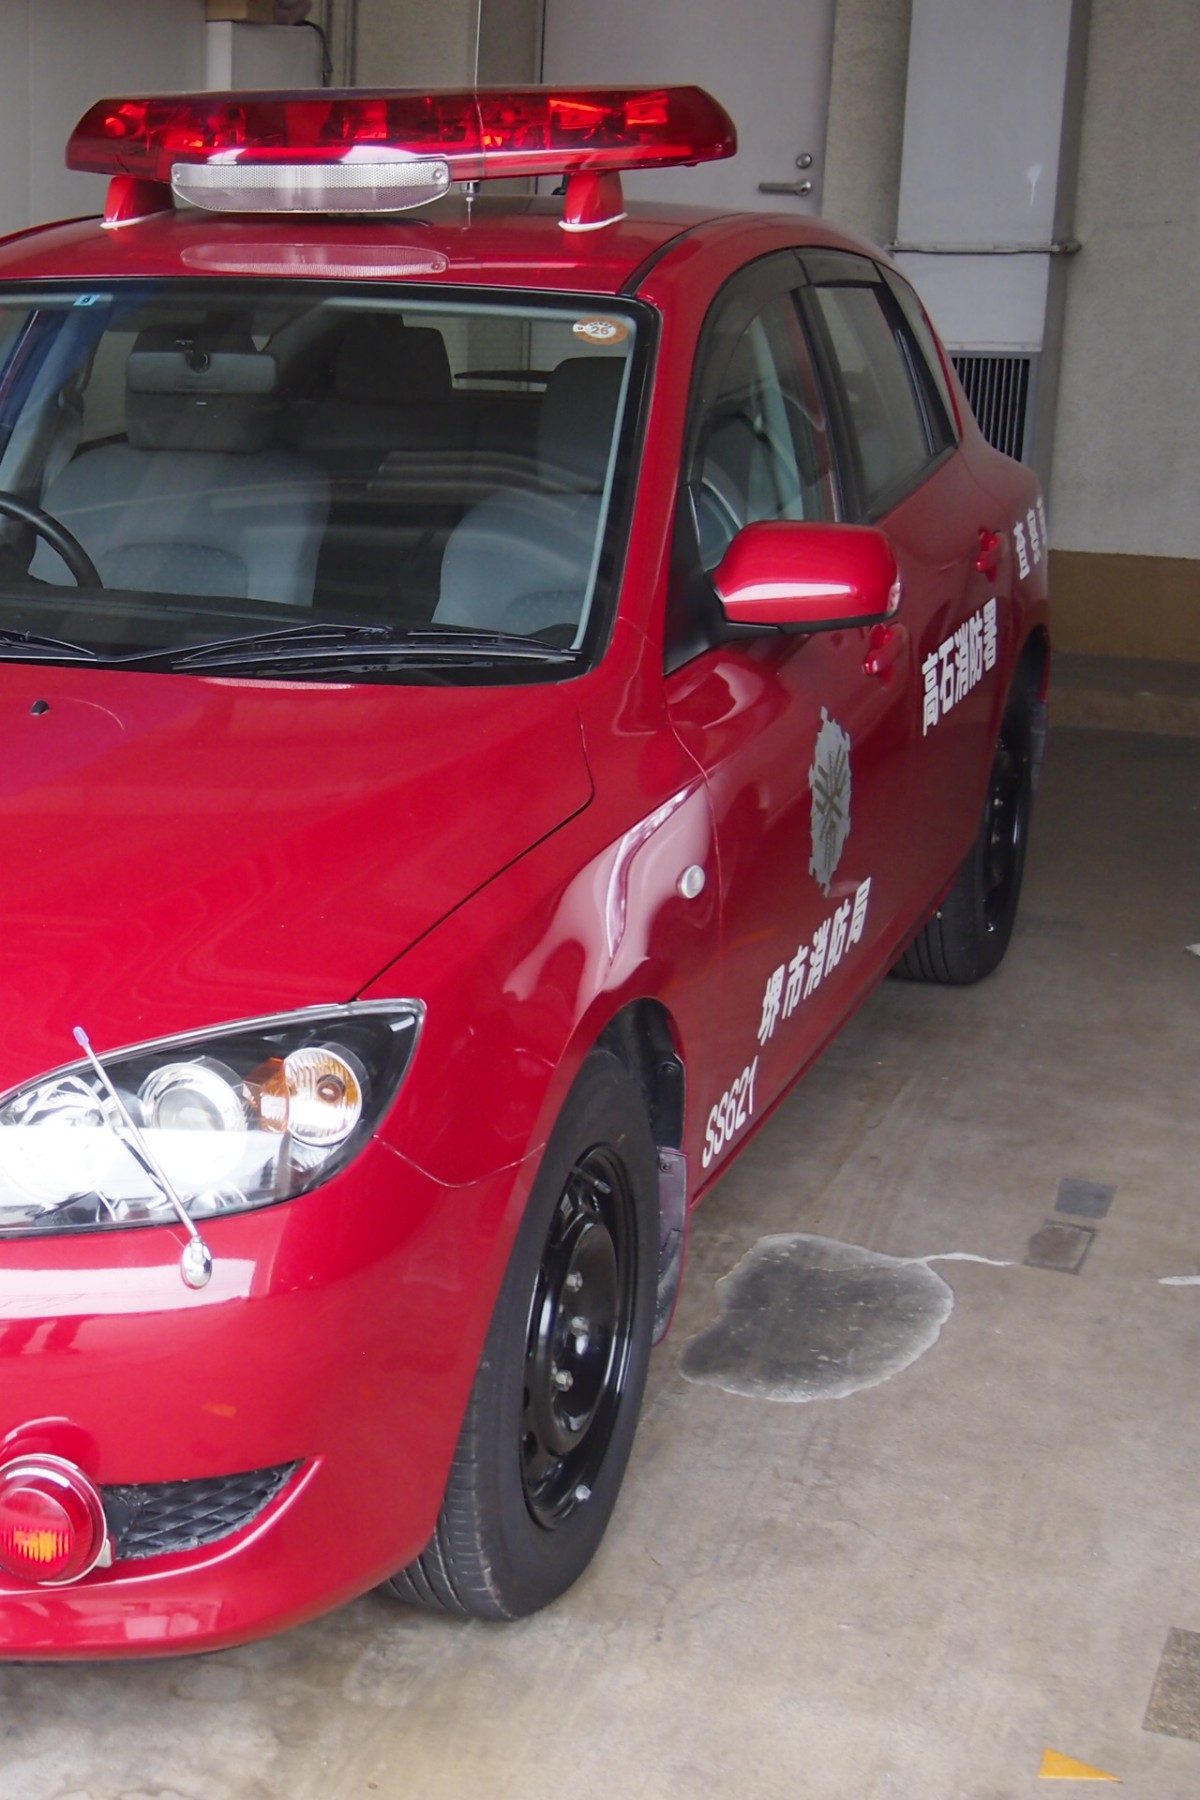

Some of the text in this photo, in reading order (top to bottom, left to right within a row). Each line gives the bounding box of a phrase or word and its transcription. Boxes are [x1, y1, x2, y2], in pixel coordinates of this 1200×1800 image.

[591, 326, 610, 336] 26
[921, 597, 998, 737] 高石消防署
[757, 876, 871, 1047] 堺市消防局
[702, 1055, 758, 1169] SS621
